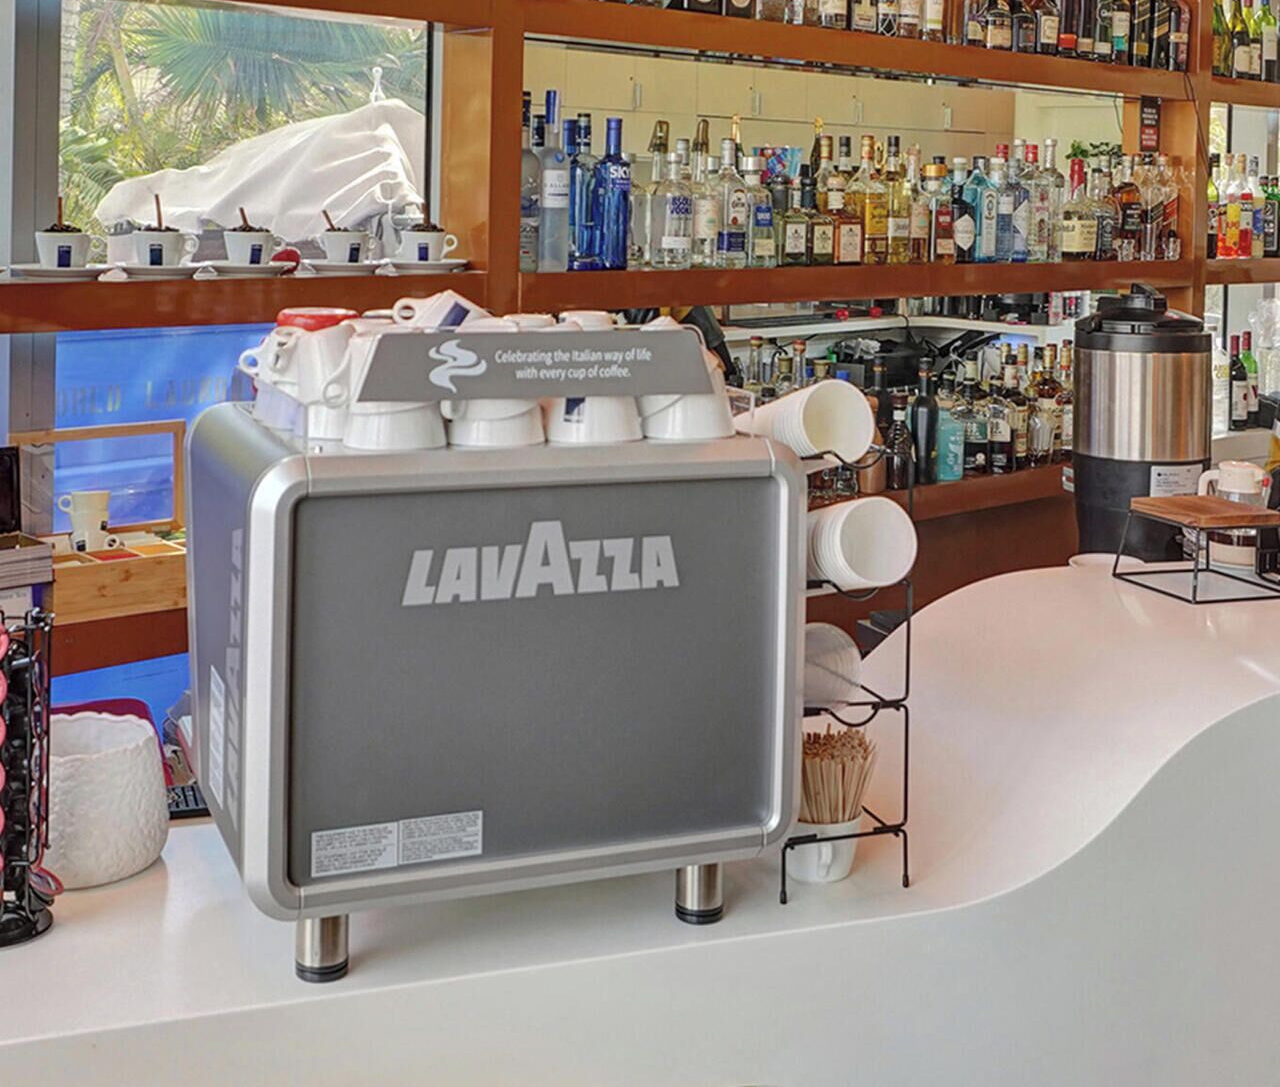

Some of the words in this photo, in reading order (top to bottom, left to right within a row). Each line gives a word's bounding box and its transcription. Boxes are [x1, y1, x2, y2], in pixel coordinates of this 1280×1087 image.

[494, 349, 553, 365] Celebrating
[553, 349, 570, 362] the
[571, 349, 603, 361] Italian
[604, 350, 624, 364] way
[624, 348, 635, 361] of
[636, 347, 652, 361] life
[515, 367, 538, 380] with
[539, 368, 567, 381] every
[568, 368, 587, 381] cup
[587, 366, 598, 379] of
[598, 366, 632, 379] coffee.
[402, 520, 680, 607] LAVAZZA
